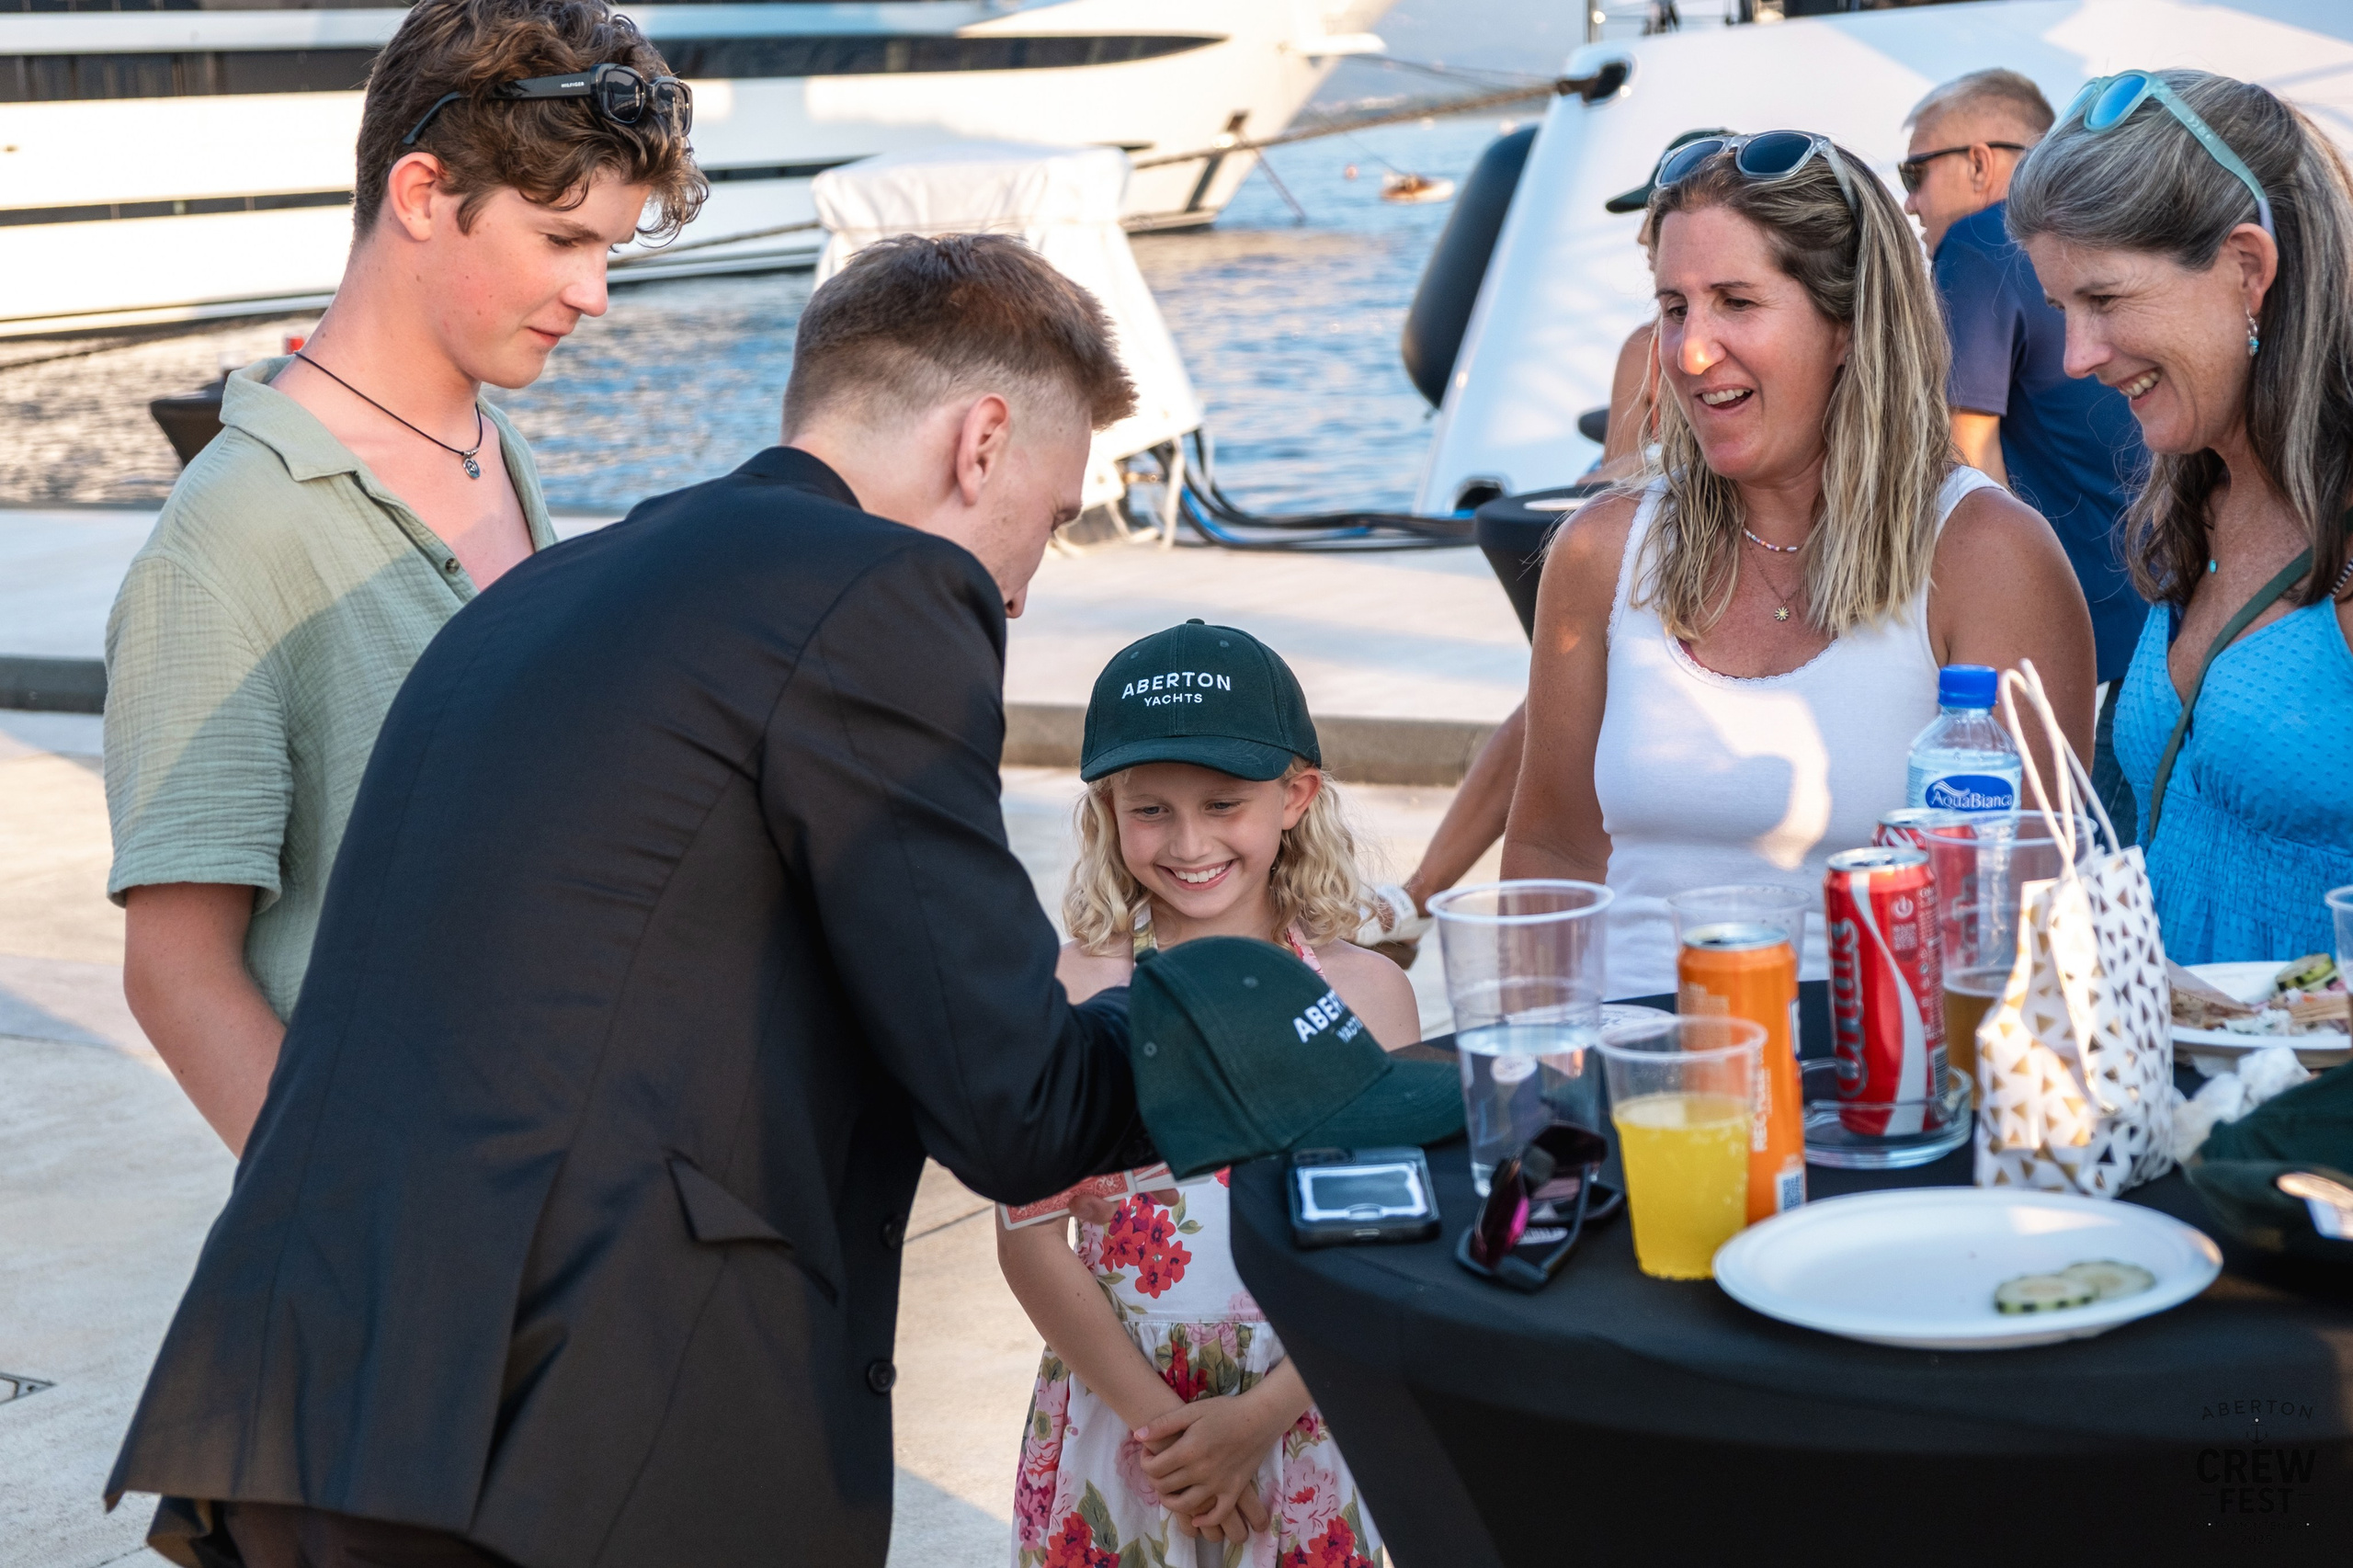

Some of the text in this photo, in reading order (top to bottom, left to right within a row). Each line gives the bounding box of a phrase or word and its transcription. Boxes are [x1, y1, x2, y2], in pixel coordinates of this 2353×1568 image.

[1121, 671, 1232, 699] ABERTON
[1143, 693, 1203, 707] YACHTS
[1931, 790, 2013, 810] AquaBianca
